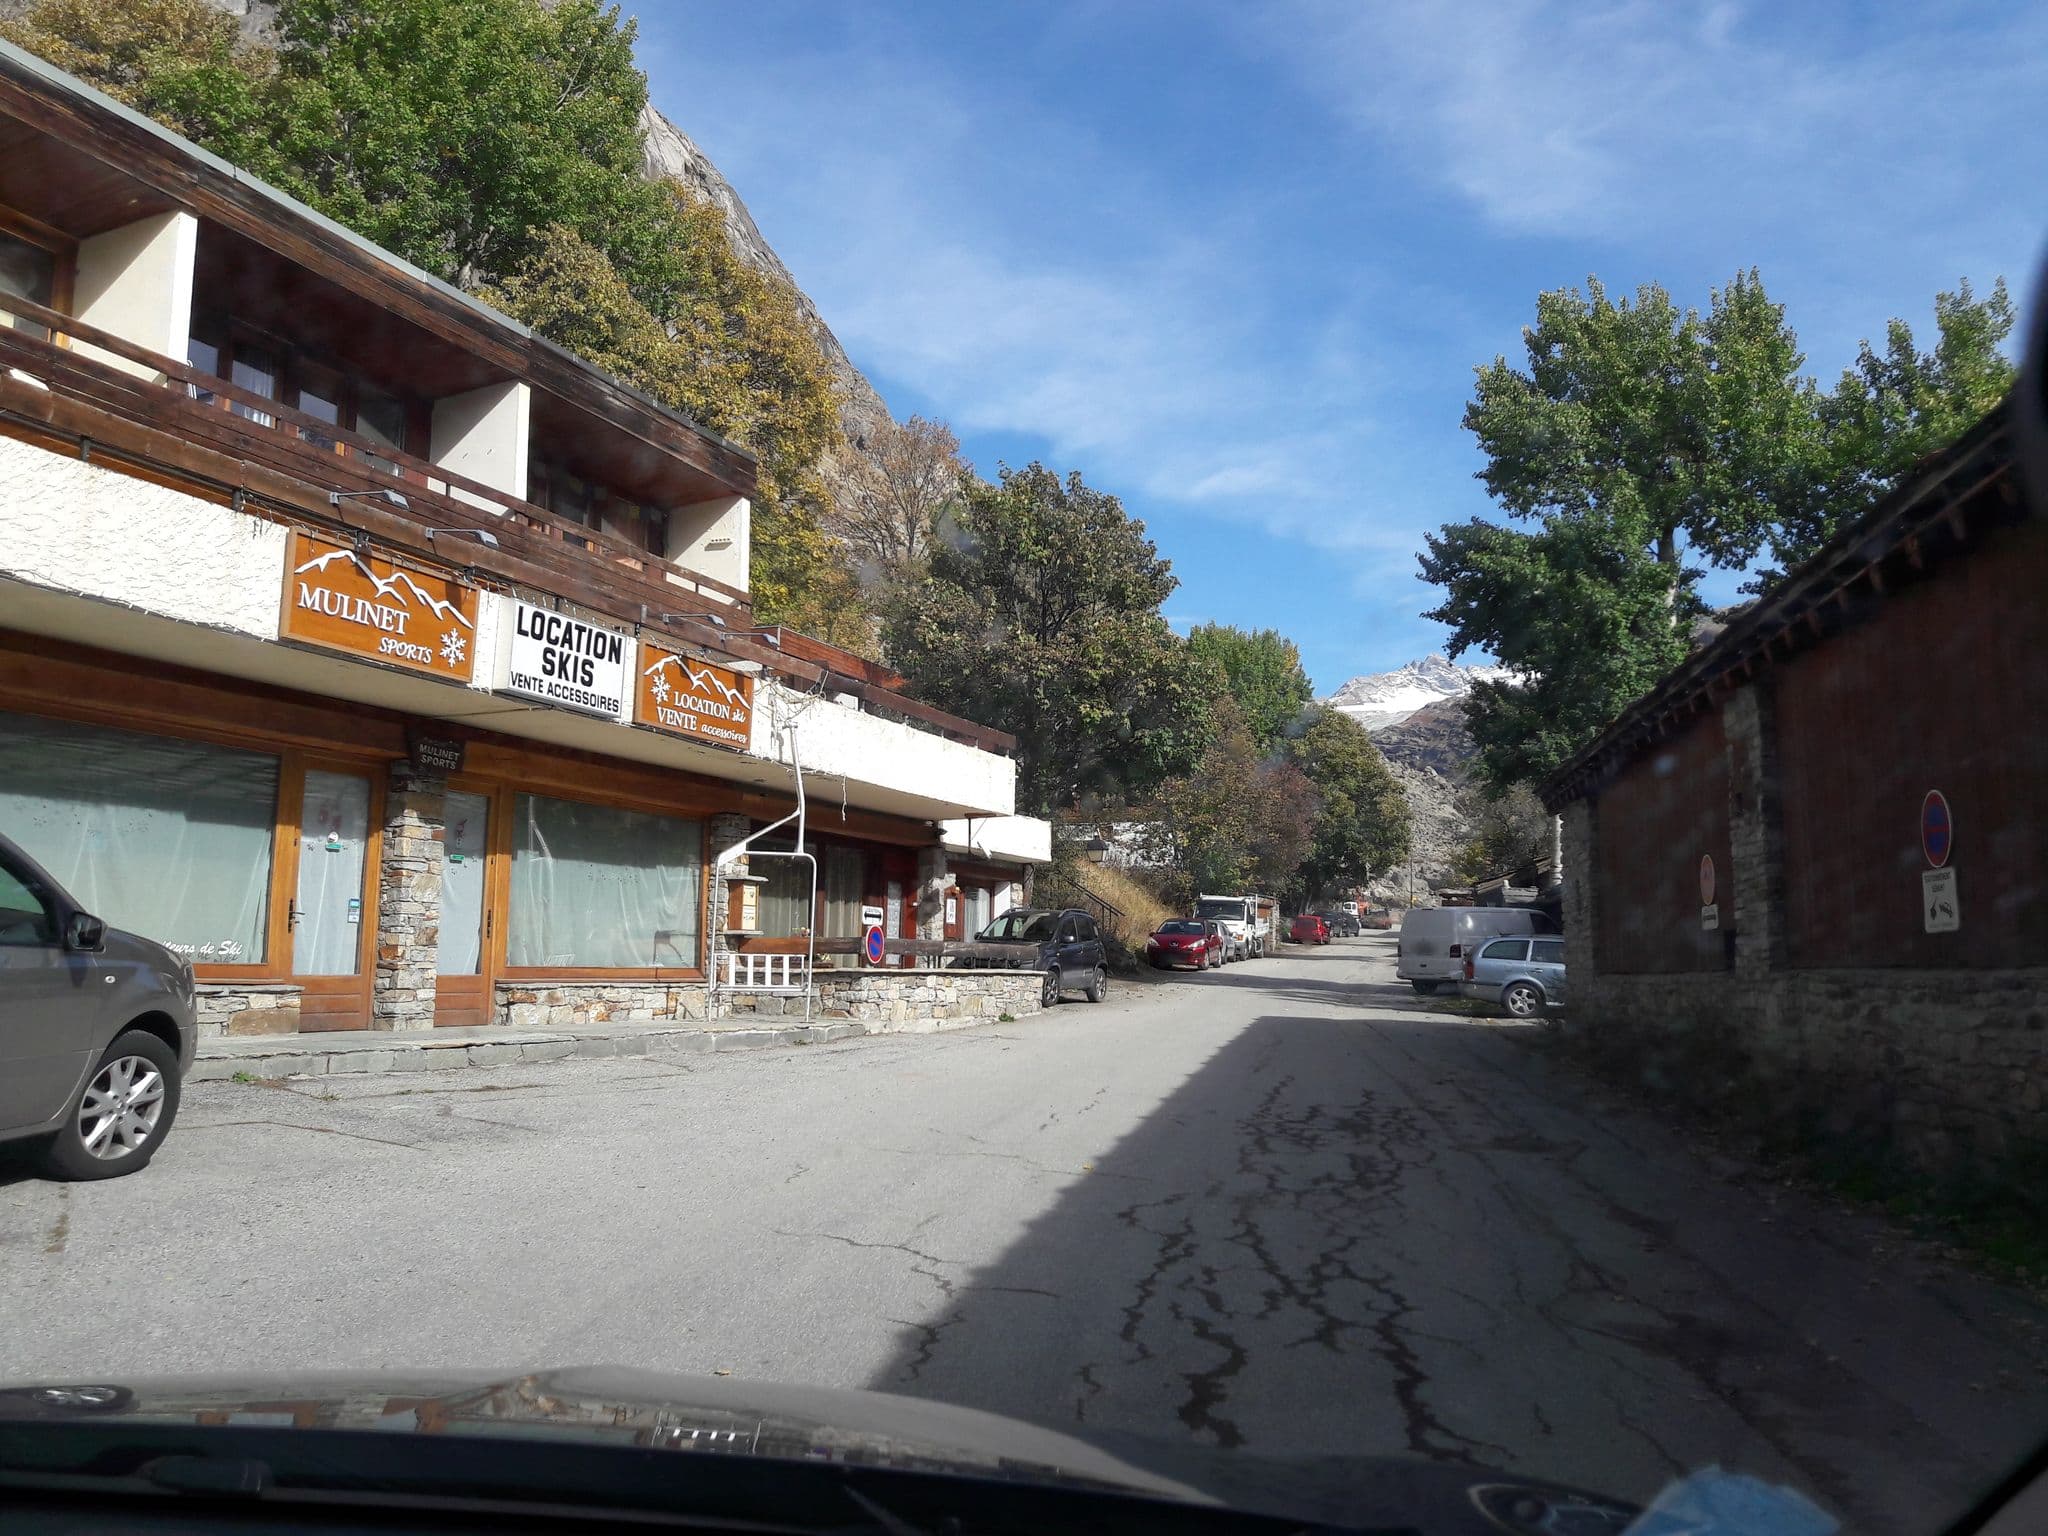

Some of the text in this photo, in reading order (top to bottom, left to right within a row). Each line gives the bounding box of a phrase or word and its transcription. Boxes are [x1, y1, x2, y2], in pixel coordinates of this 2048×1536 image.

[298, 582, 410, 635] MULINET
[379, 637, 433, 664] SPORTS
[517, 605, 622, 665] LOCATION
[541, 646, 595, 687] SKIS
[510, 671, 620, 713] VENTE ACCESSOIRES
[674, 691, 731, 720] LOCATION
[656, 706, 748, 744] VENTE accessoires
[419, 743, 460, 761] MULINET
[420, 754, 457, 770] SPORTS
[199, 941, 216, 954] de
[218, 940, 243, 955] Ski
